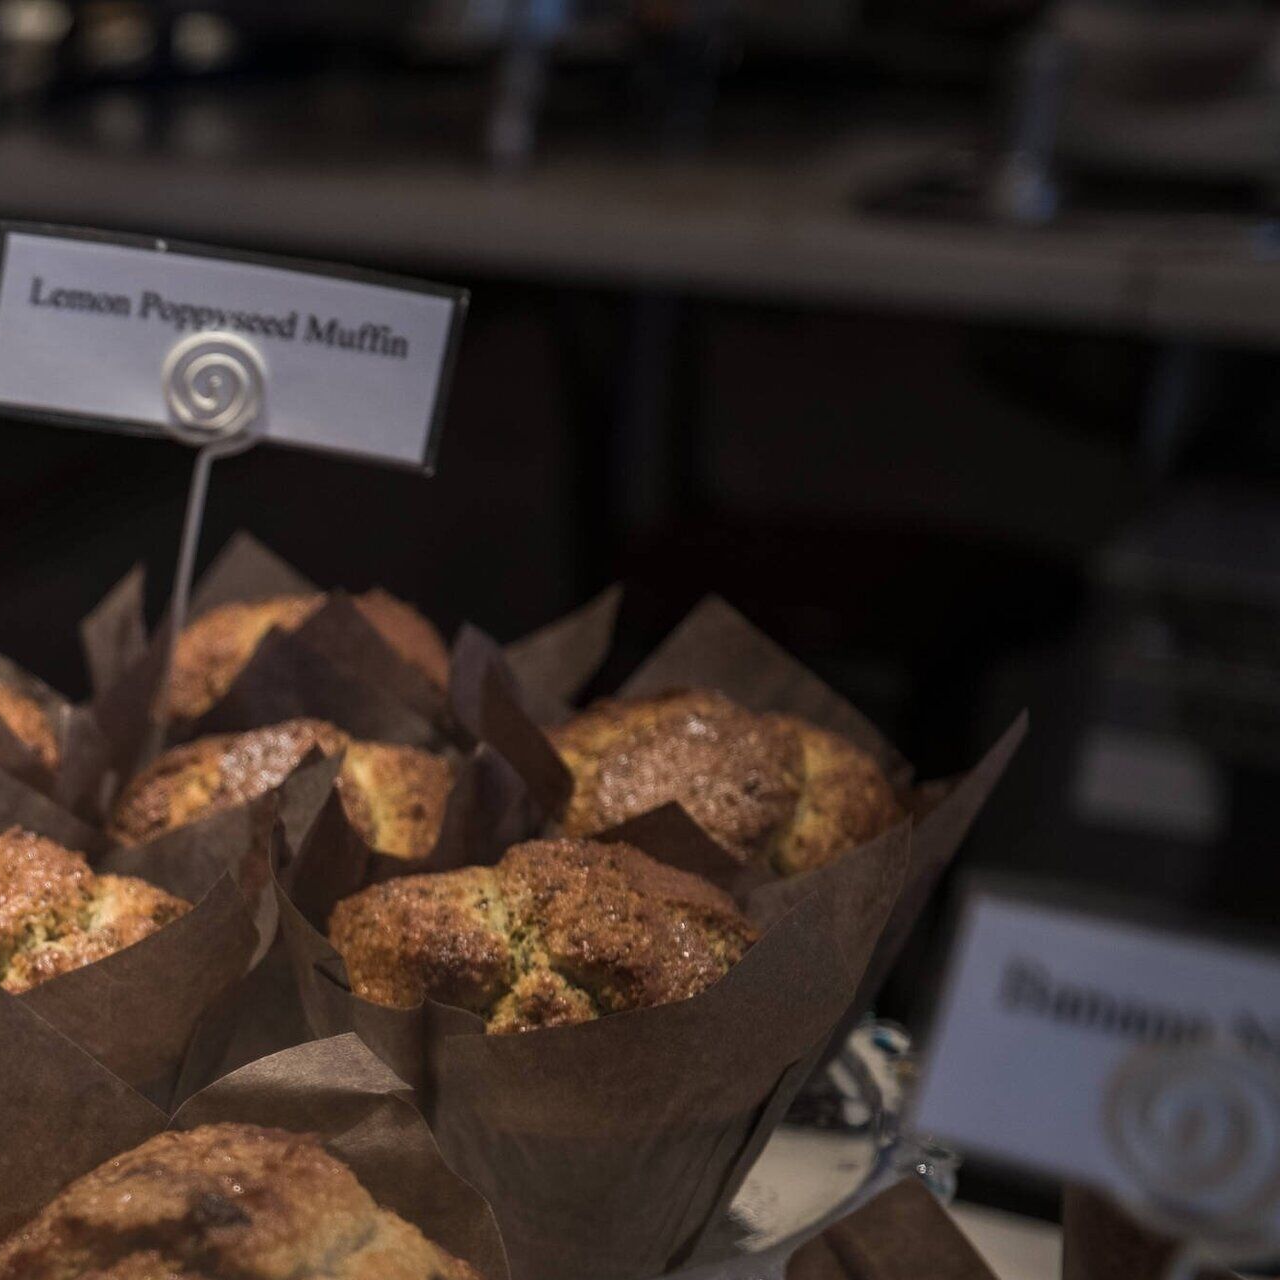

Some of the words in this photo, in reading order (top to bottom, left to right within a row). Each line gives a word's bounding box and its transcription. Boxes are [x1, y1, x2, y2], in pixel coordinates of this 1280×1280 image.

[28, 274, 132, 317] Lemon
[138, 289, 298, 341] Poppyseed
[302, 313, 410, 360] Muffin
